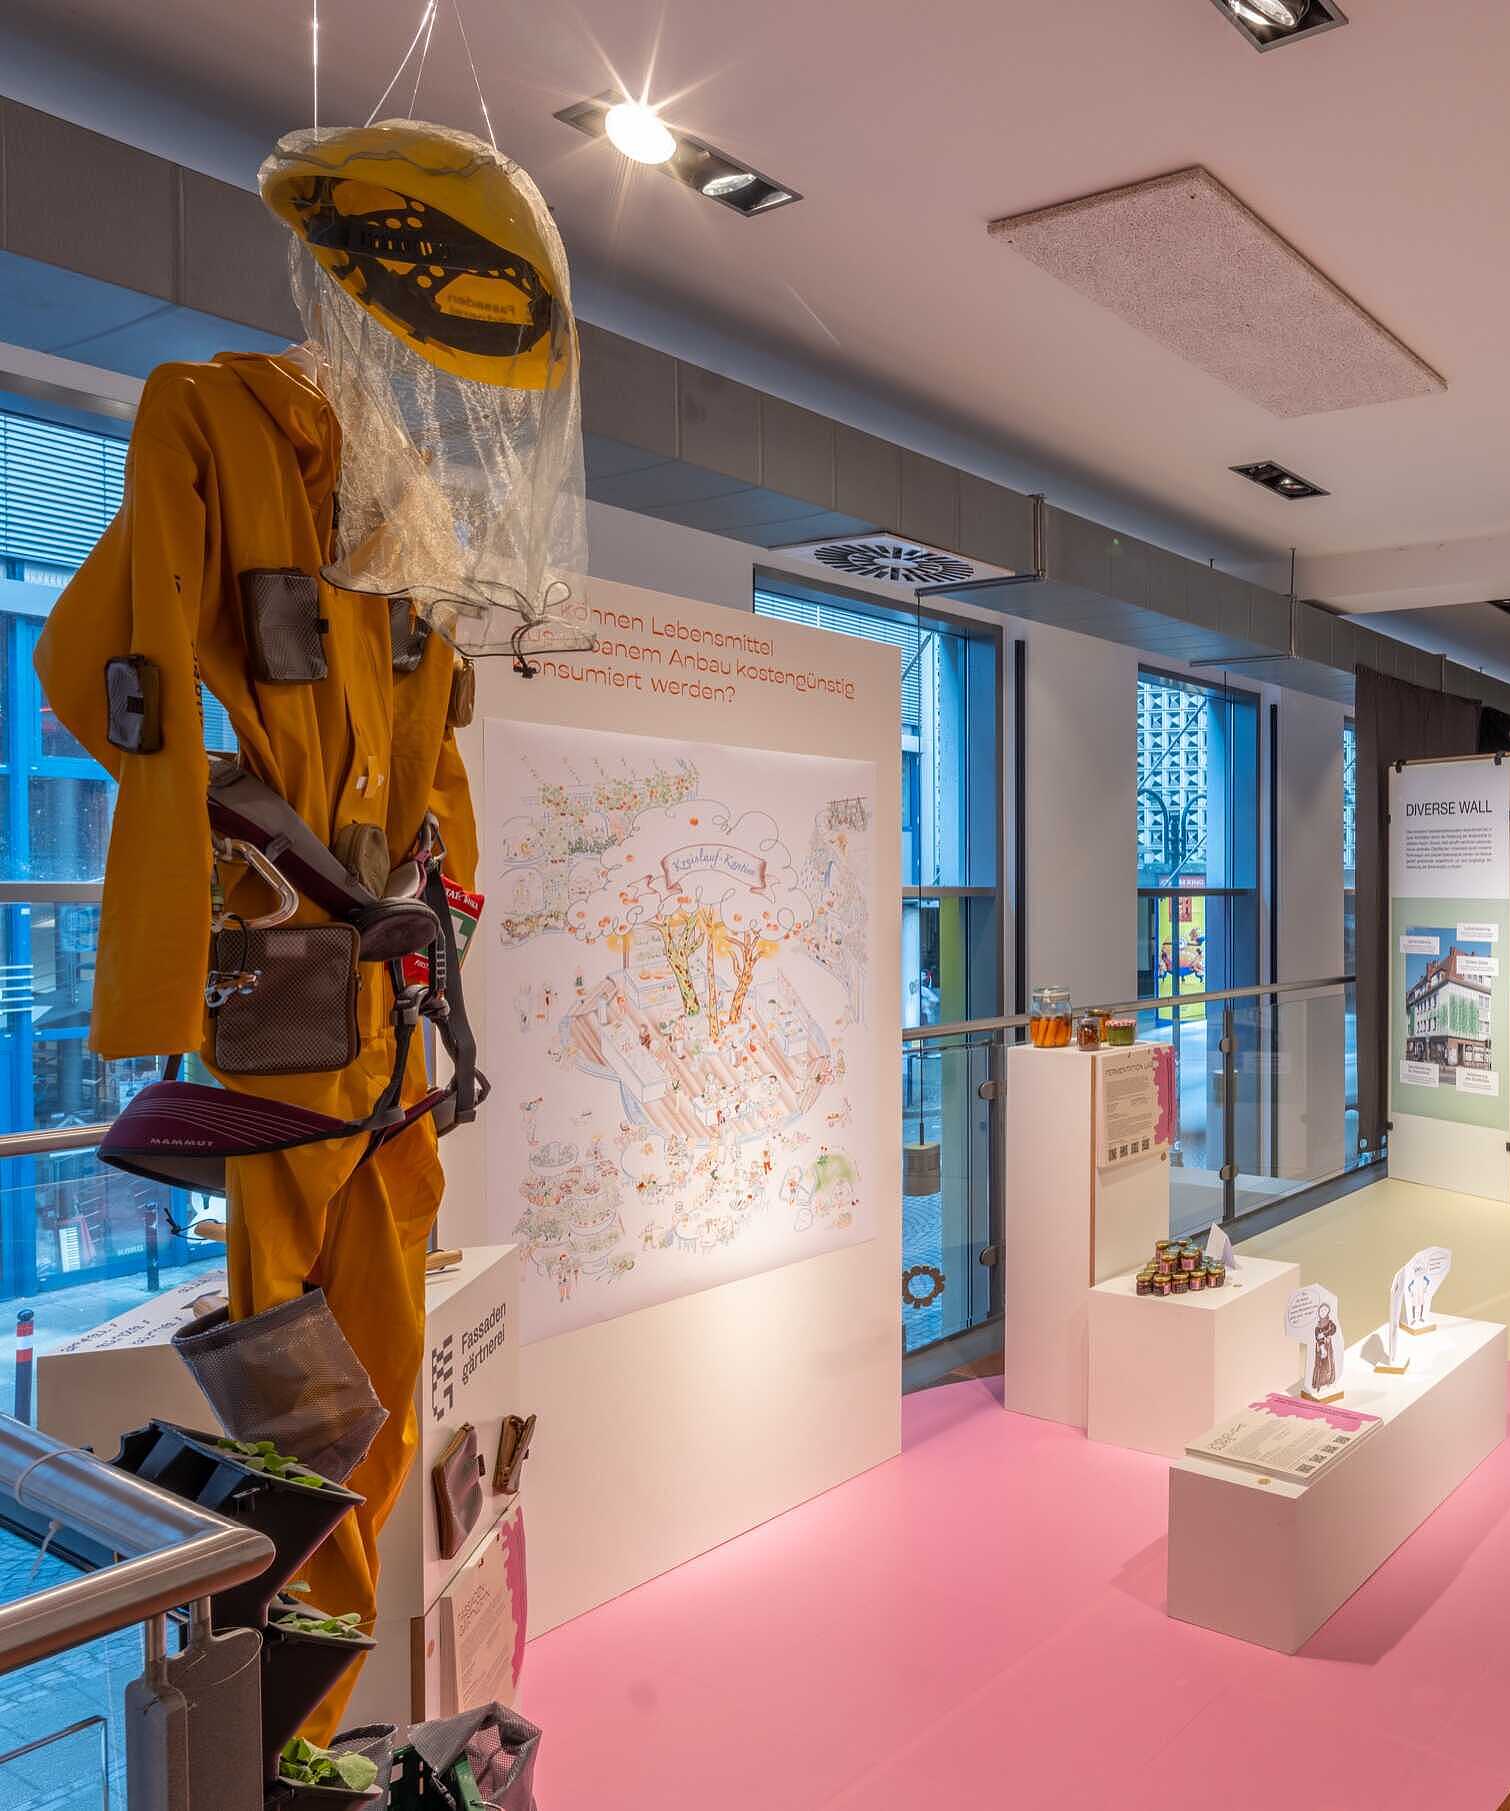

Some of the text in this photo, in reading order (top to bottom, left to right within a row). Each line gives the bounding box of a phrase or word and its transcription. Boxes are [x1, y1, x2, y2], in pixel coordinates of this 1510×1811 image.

[651, 615, 775, 657] Lebensmittel
[650, 676, 736, 704] werden?
[669, 648, 731, 676] Anbau
[735, 662, 856, 699] kostengünstig
[1406, 799, 1493, 817] DIVERSE WALL
[150, 1137, 214, 1148] MAMMUT
[461, 1302, 507, 1355] Fassaden
[462, 1322, 506, 1386] gärtnerei
